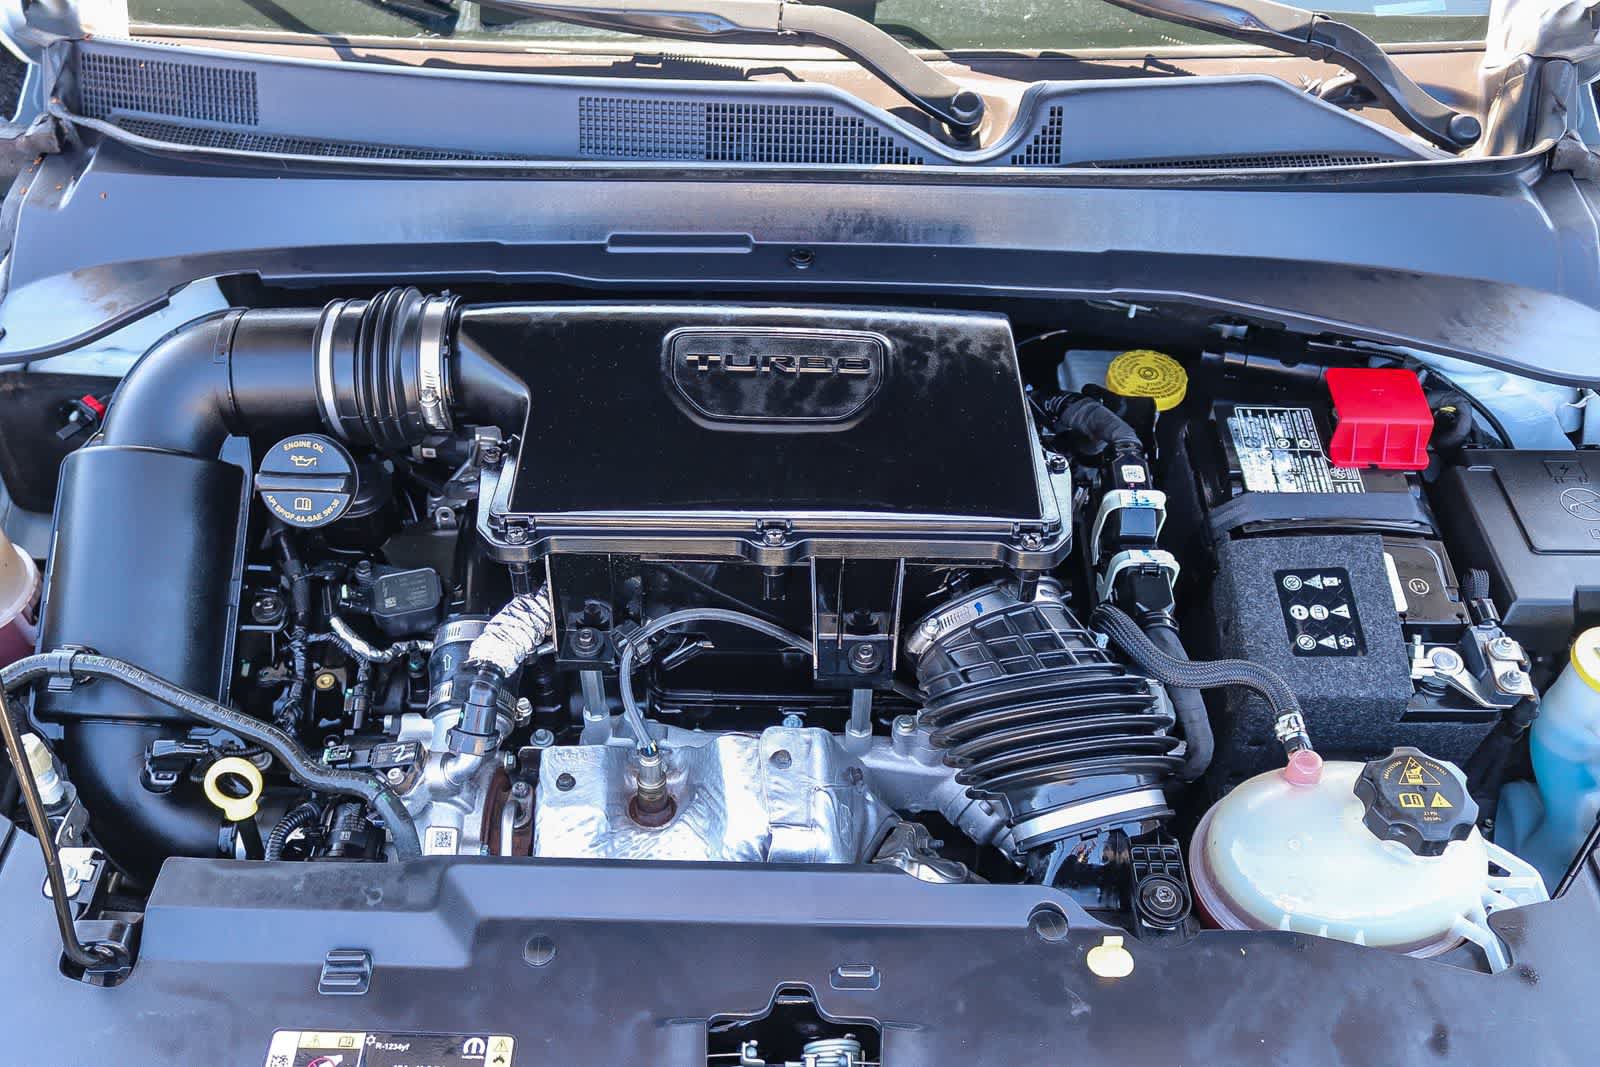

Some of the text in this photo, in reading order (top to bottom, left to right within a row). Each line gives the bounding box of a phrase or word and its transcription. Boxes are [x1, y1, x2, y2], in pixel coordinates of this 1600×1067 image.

[686, 353, 870, 375] TURBO
[283, 440, 325, 454] ENGINE OIL
[375, 1042, 410, 1053] R-1234yf
